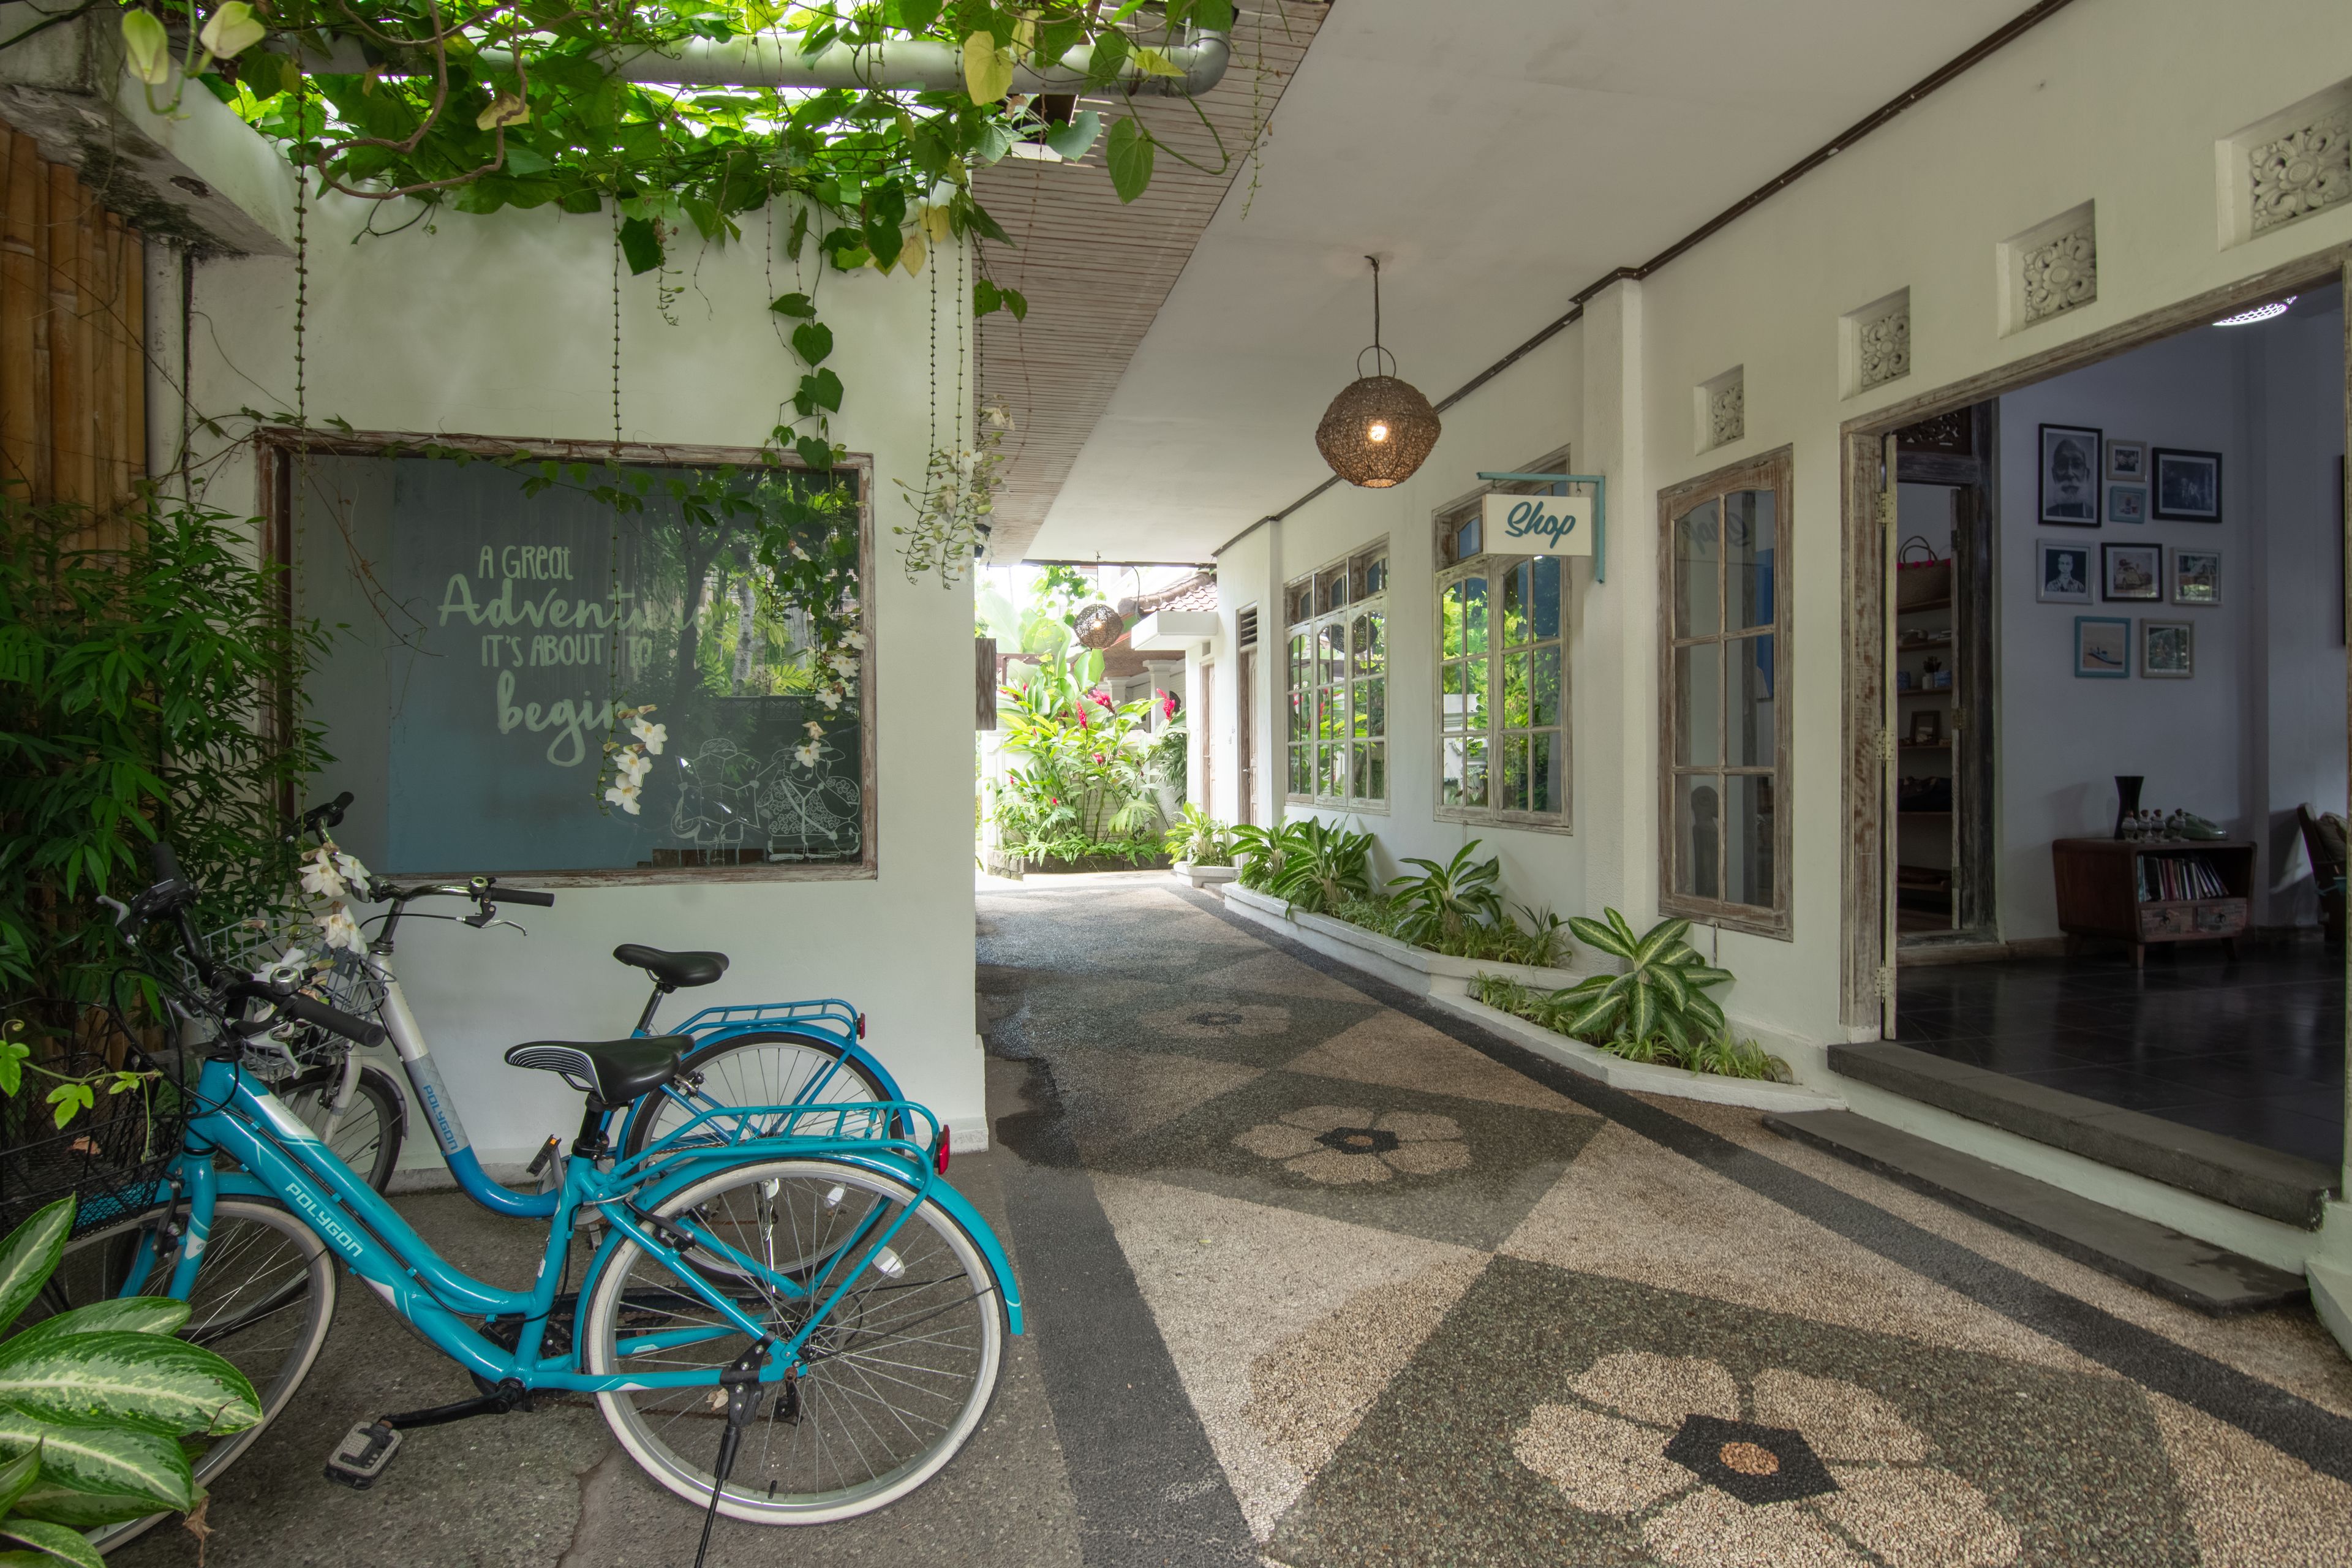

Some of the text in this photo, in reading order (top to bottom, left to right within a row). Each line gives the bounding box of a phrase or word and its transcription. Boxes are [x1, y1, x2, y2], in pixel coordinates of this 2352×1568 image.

[1505, 501, 1576, 549] Shop
[478, 545, 494, 579] A
[530, 633, 605, 666] ABOUT
[626, 636, 652, 668] TO
[497, 669, 644, 767] begin
[423, 1084, 459, 1150] POLYGON
[285, 1182, 363, 1257] POLYGON
